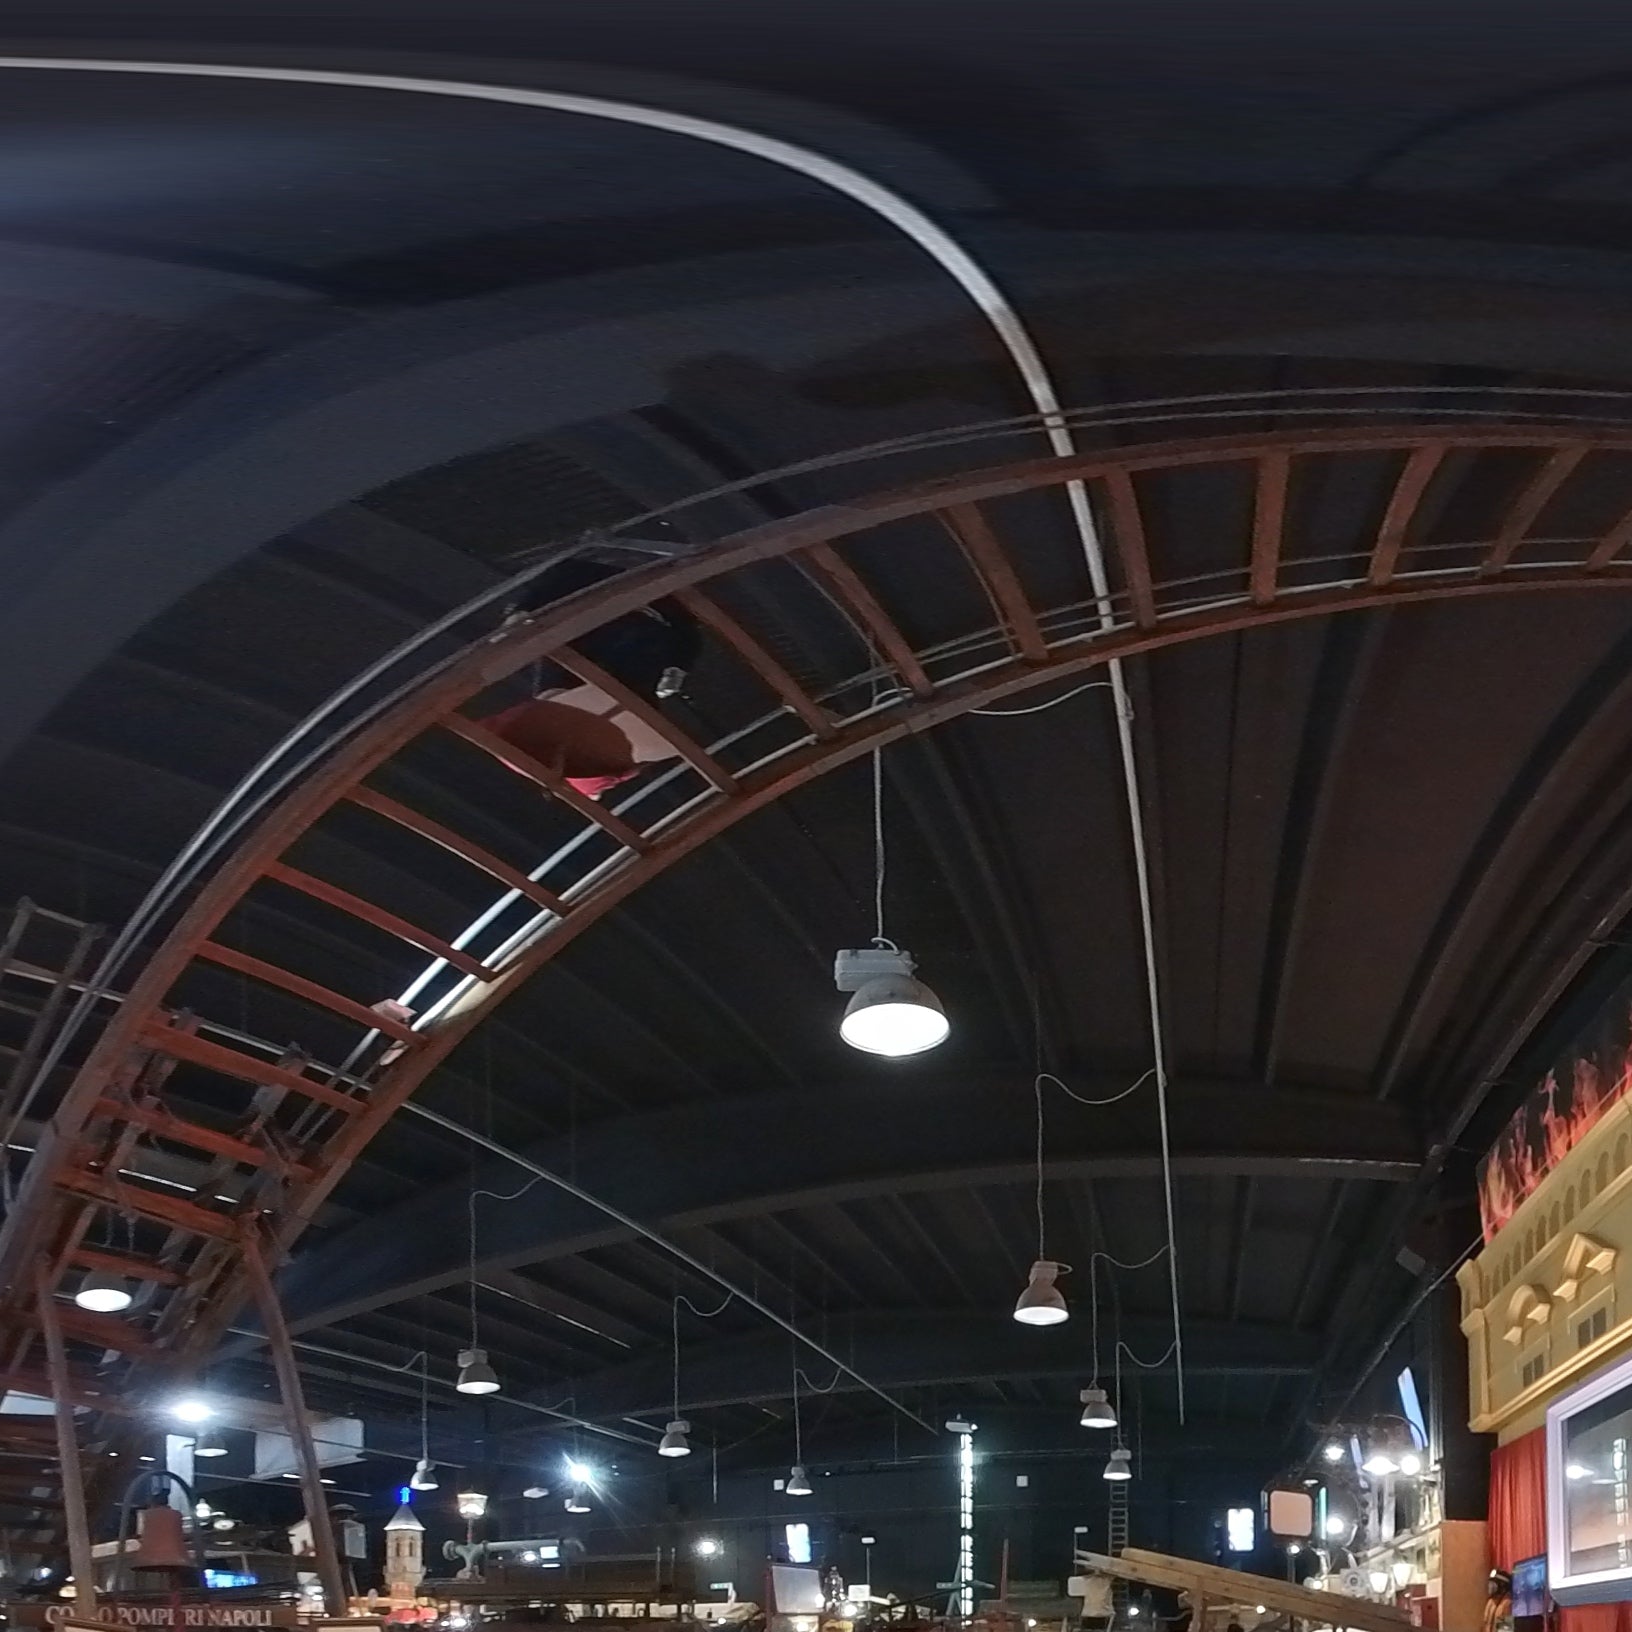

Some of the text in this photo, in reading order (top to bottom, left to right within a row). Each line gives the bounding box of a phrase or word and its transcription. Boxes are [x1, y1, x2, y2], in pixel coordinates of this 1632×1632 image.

[45, 1606, 272, 1627] COO POMPIRI NAPOLI
